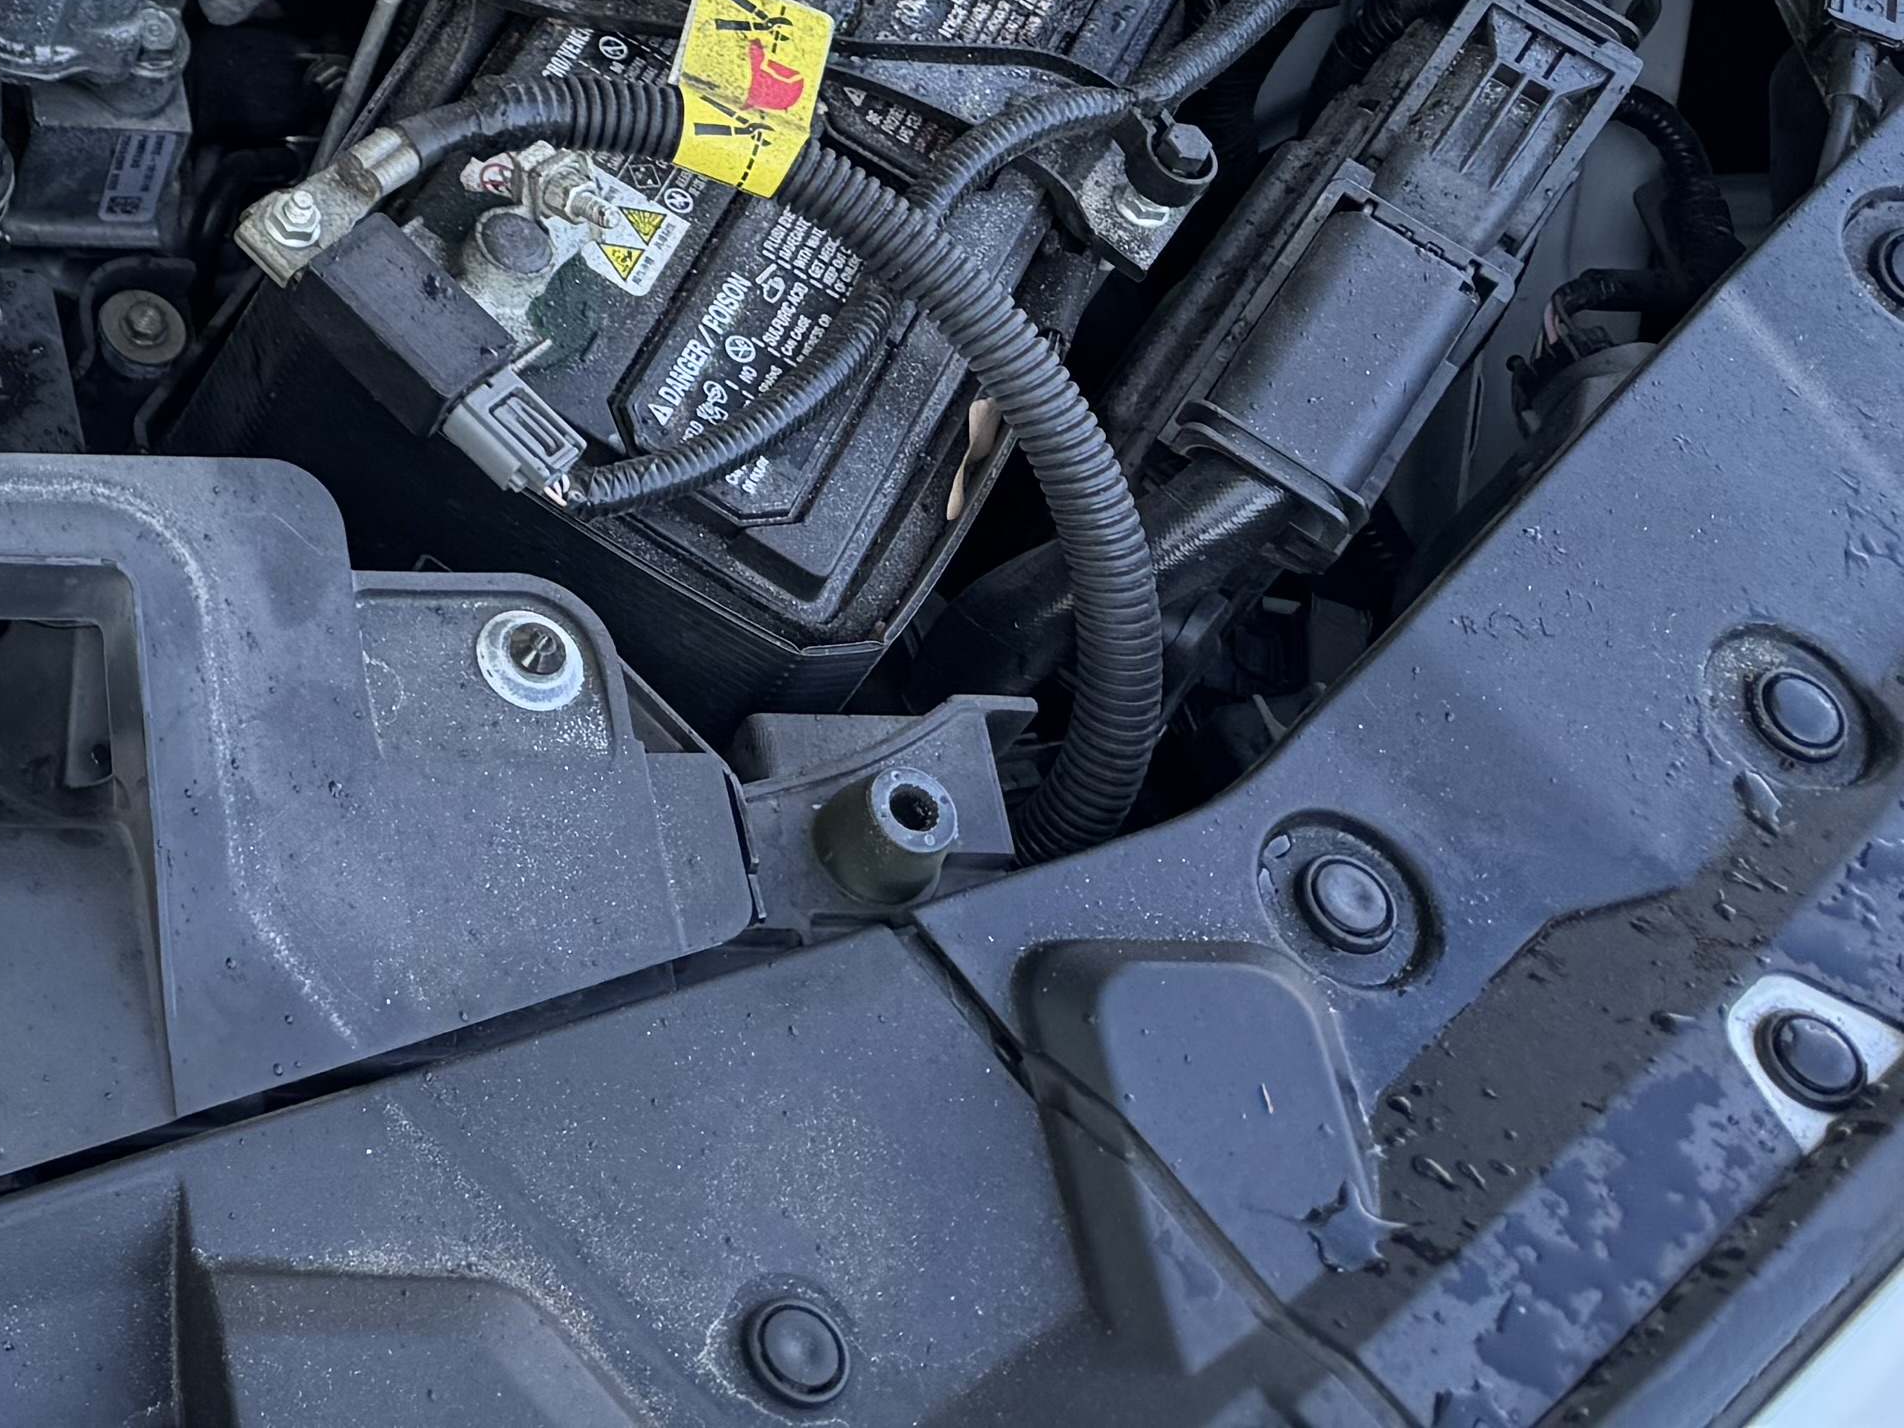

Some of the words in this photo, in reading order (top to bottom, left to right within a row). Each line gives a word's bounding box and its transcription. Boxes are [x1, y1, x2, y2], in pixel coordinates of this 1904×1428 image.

[763, 223, 787, 253] FLUSH
[807, 258, 826, 279] GET
[737, 363, 759, 385] NO
